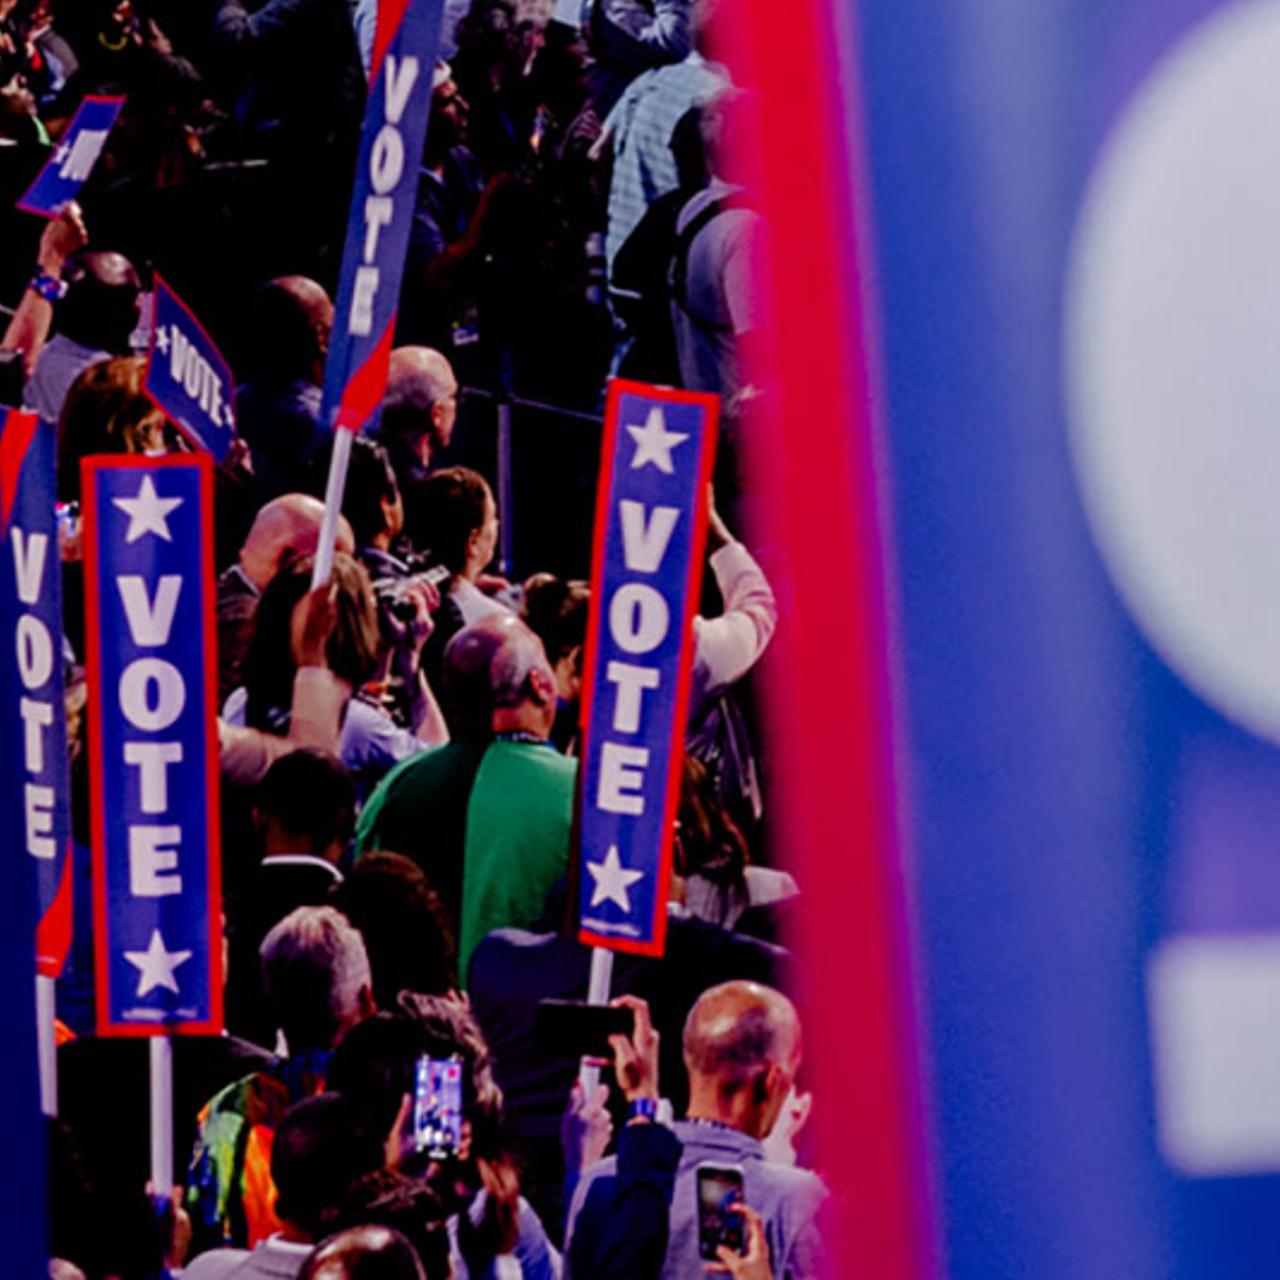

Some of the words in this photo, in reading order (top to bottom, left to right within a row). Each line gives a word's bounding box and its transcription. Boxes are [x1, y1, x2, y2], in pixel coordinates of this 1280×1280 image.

[348, 55, 418, 336] VOTE
[171, 324, 222, 428] VOTE
[11, 526, 57, 860] VOTE
[116, 574, 187, 899] VOTE
[595, 499, 681, 816] VOTE
